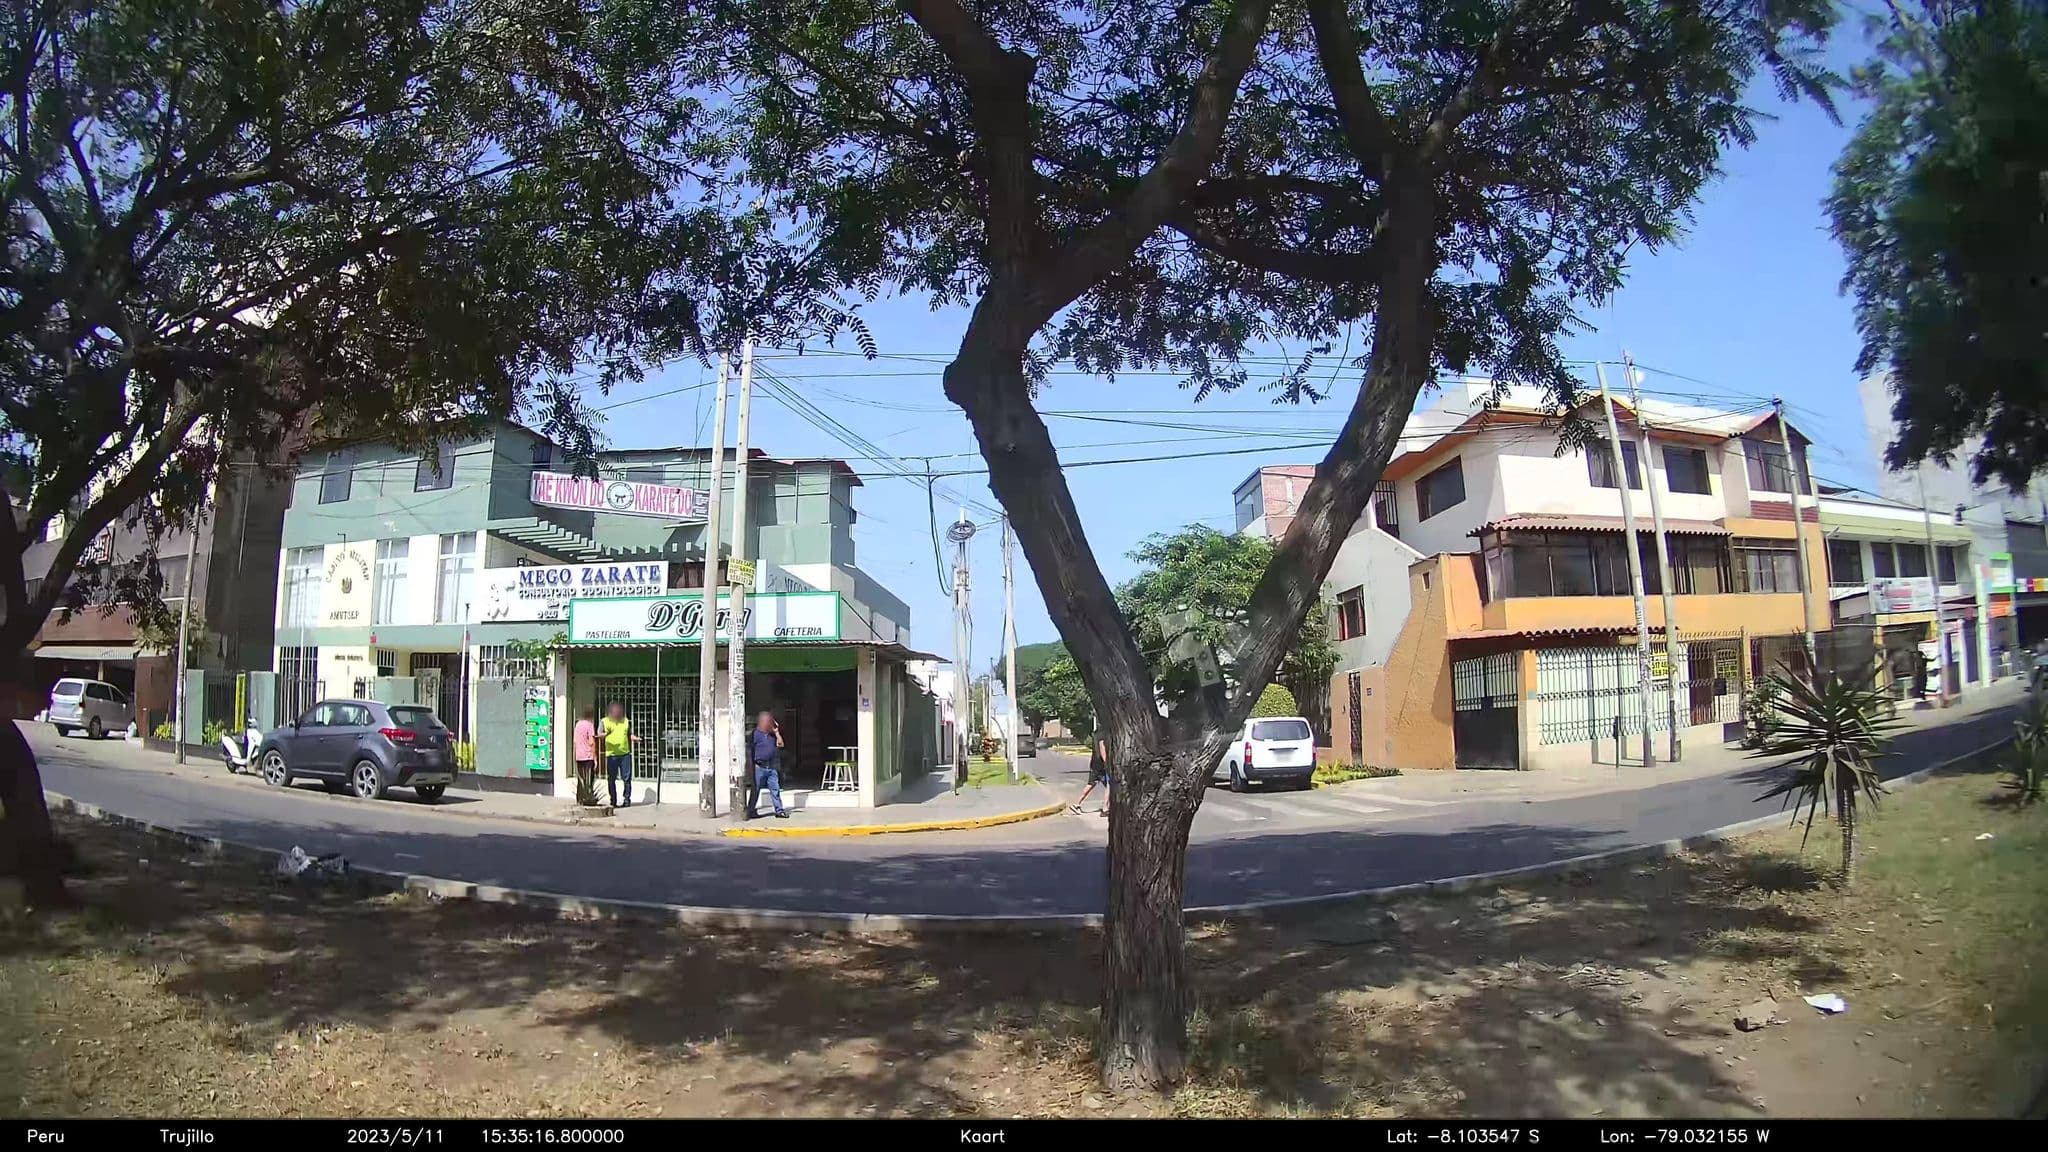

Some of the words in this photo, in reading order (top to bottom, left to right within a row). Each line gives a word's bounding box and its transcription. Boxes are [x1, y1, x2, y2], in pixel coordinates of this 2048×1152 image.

[533, 473, 551, 502] TAE
[555, 476, 587, 506] KWON
[590, 481, 605, 507] DO
[635, 484, 675, 514] KARATE
[519, 568, 573, 586] MEGO
[581, 564, 662, 586] ZARATE
[585, 630, 631, 640] PASTELERIA
[774, 626, 823, 637] CAFETERIA
